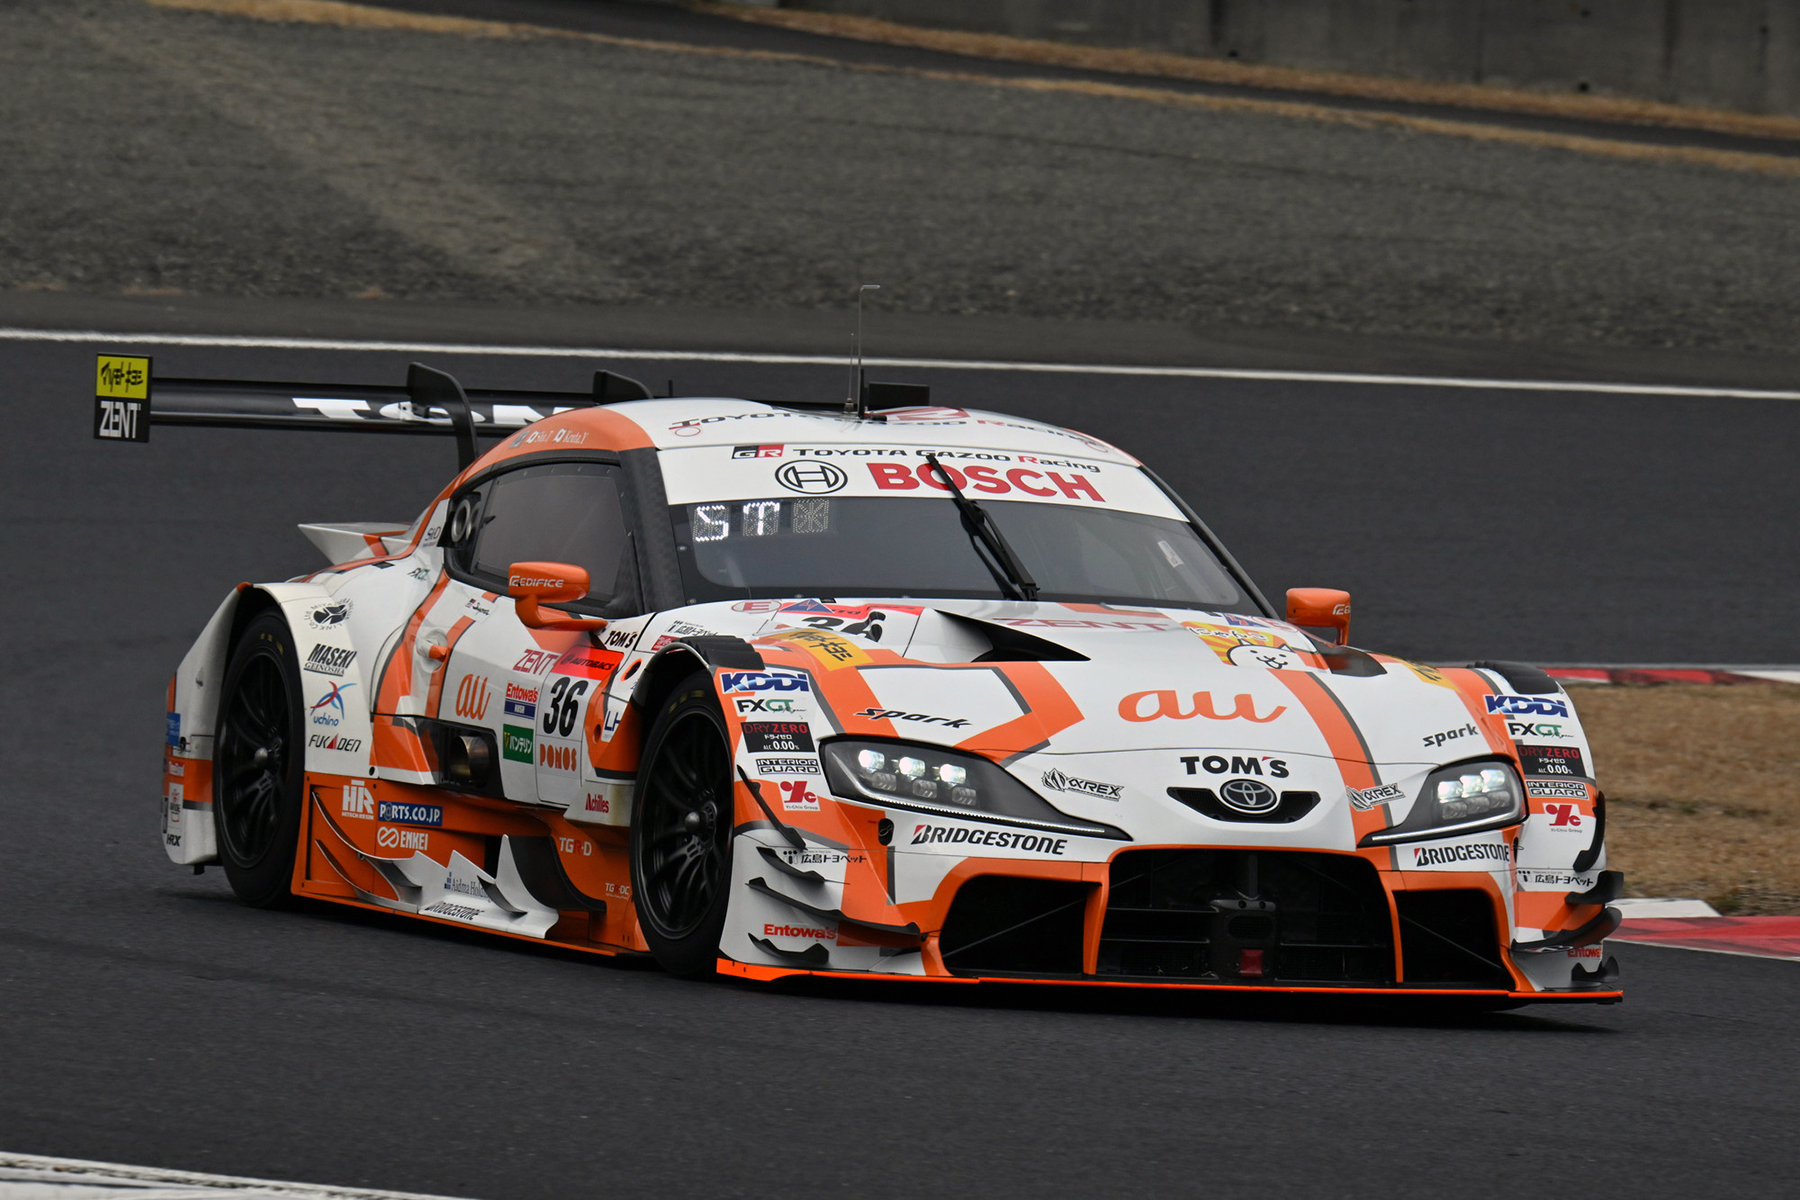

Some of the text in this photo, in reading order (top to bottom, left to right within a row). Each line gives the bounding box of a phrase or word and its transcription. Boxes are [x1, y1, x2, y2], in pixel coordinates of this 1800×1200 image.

[99, 400, 139, 439] ZENT
[732, 444, 1101, 473] GR TOYOTA GAZOO Racing
[866, 462, 1106, 502] BOSCH
[519, 577, 565, 588] EDIFICE
[992, 617, 1169, 631] ZENT
[604, 630, 638, 648] TOM'S
[306, 643, 358, 670] MASEKI
[512, 649, 559, 676] ZENT
[571, 657, 615, 671] AUTOBACS
[304, 660, 345, 676] GEINOSHA
[505, 682, 539, 703] Entowa's
[721, 672, 810, 692] KDDI
[456, 673, 491, 721] au
[543, 677, 589, 738] 36
[736, 699, 794, 713] FXGT
[1118, 689, 1287, 723] au
[1484, 695, 1569, 718] KDDI
[312, 714, 340, 728] uchino
[743, 723, 808, 734] DRY ZERO
[856, 707, 973, 729] spark
[1423, 722, 1478, 747] spark
[1508, 722, 1562, 736] FXGT
[540, 744, 577, 772] PONOS
[1518, 746, 1580, 759] DRY ZERO
[1179, 755, 1290, 779] TOM'S
[1527, 781, 1586, 790] INTERIOR
[1530, 788, 1587, 798] GUARD
[585, 792, 610, 814] Achilles
[399, 830, 429, 851] ENKEI
[911, 824, 1067, 855] BRIDGESTONE
[801, 853, 867, 864] 広島トヨペット
[1413, 843, 1510, 867] BRIDGESTONE
[1534, 874, 1594, 887] 広島トヨペット
[763, 923, 836, 940] Entowa's
